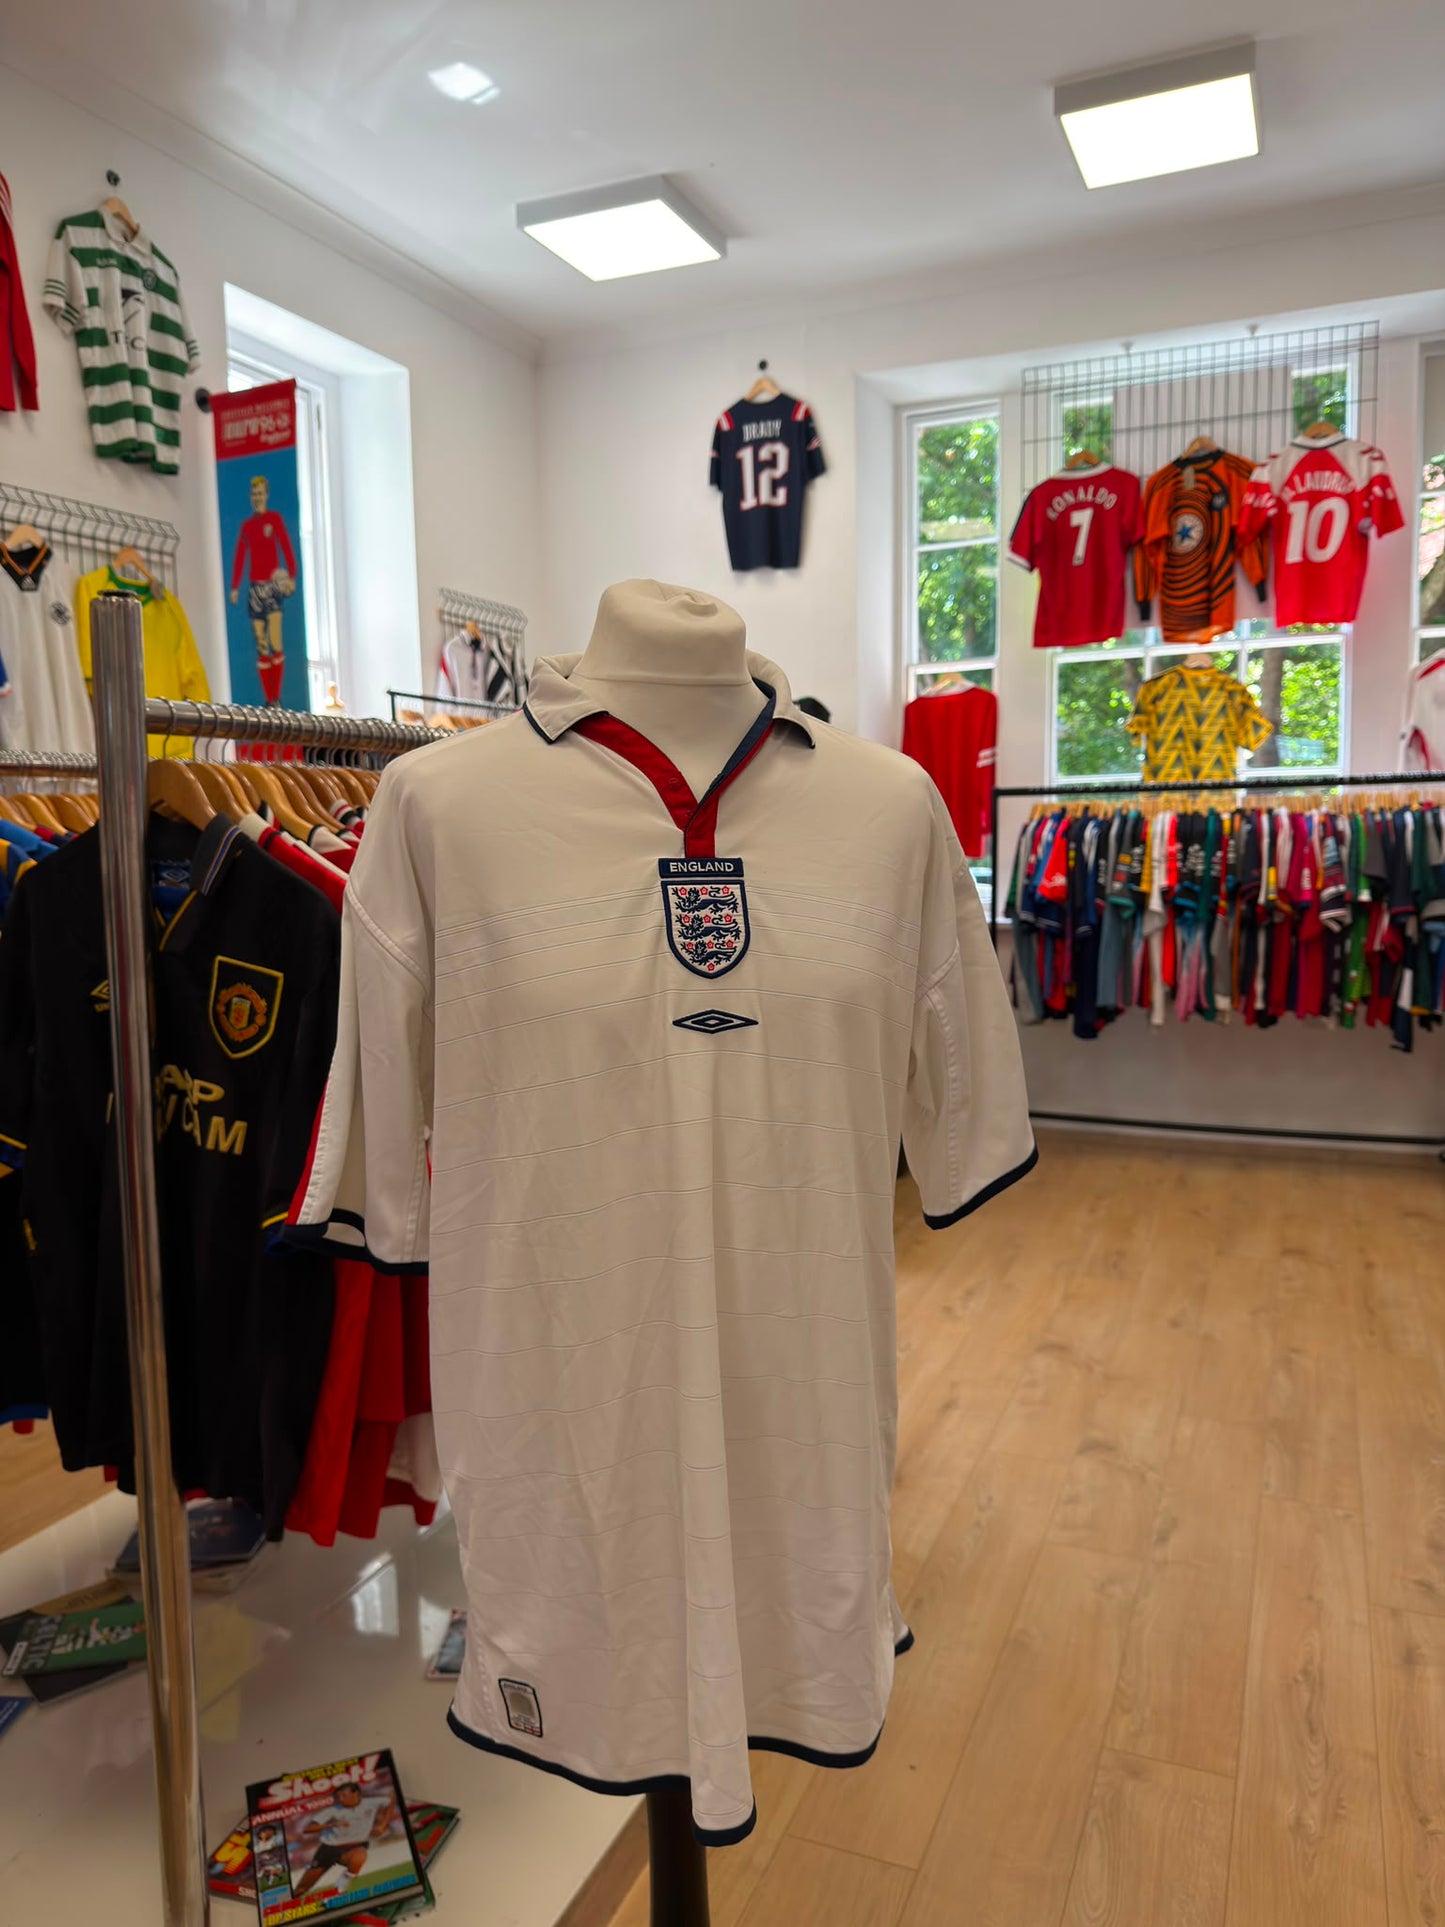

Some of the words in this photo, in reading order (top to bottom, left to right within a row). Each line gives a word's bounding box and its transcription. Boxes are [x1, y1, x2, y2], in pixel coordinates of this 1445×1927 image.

[742, 418, 782, 442] BRADY
[735, 441, 790, 511] 12
[1046, 484, 1118, 521] RONALDO
[1070, 507, 1095, 567] 7
[1285, 496, 1350, 565] 10
[669, 861, 735, 873] ENGLAND
[267, 1752, 381, 1803] Shoot!
[251, 1805, 304, 1826] ANNUAL
